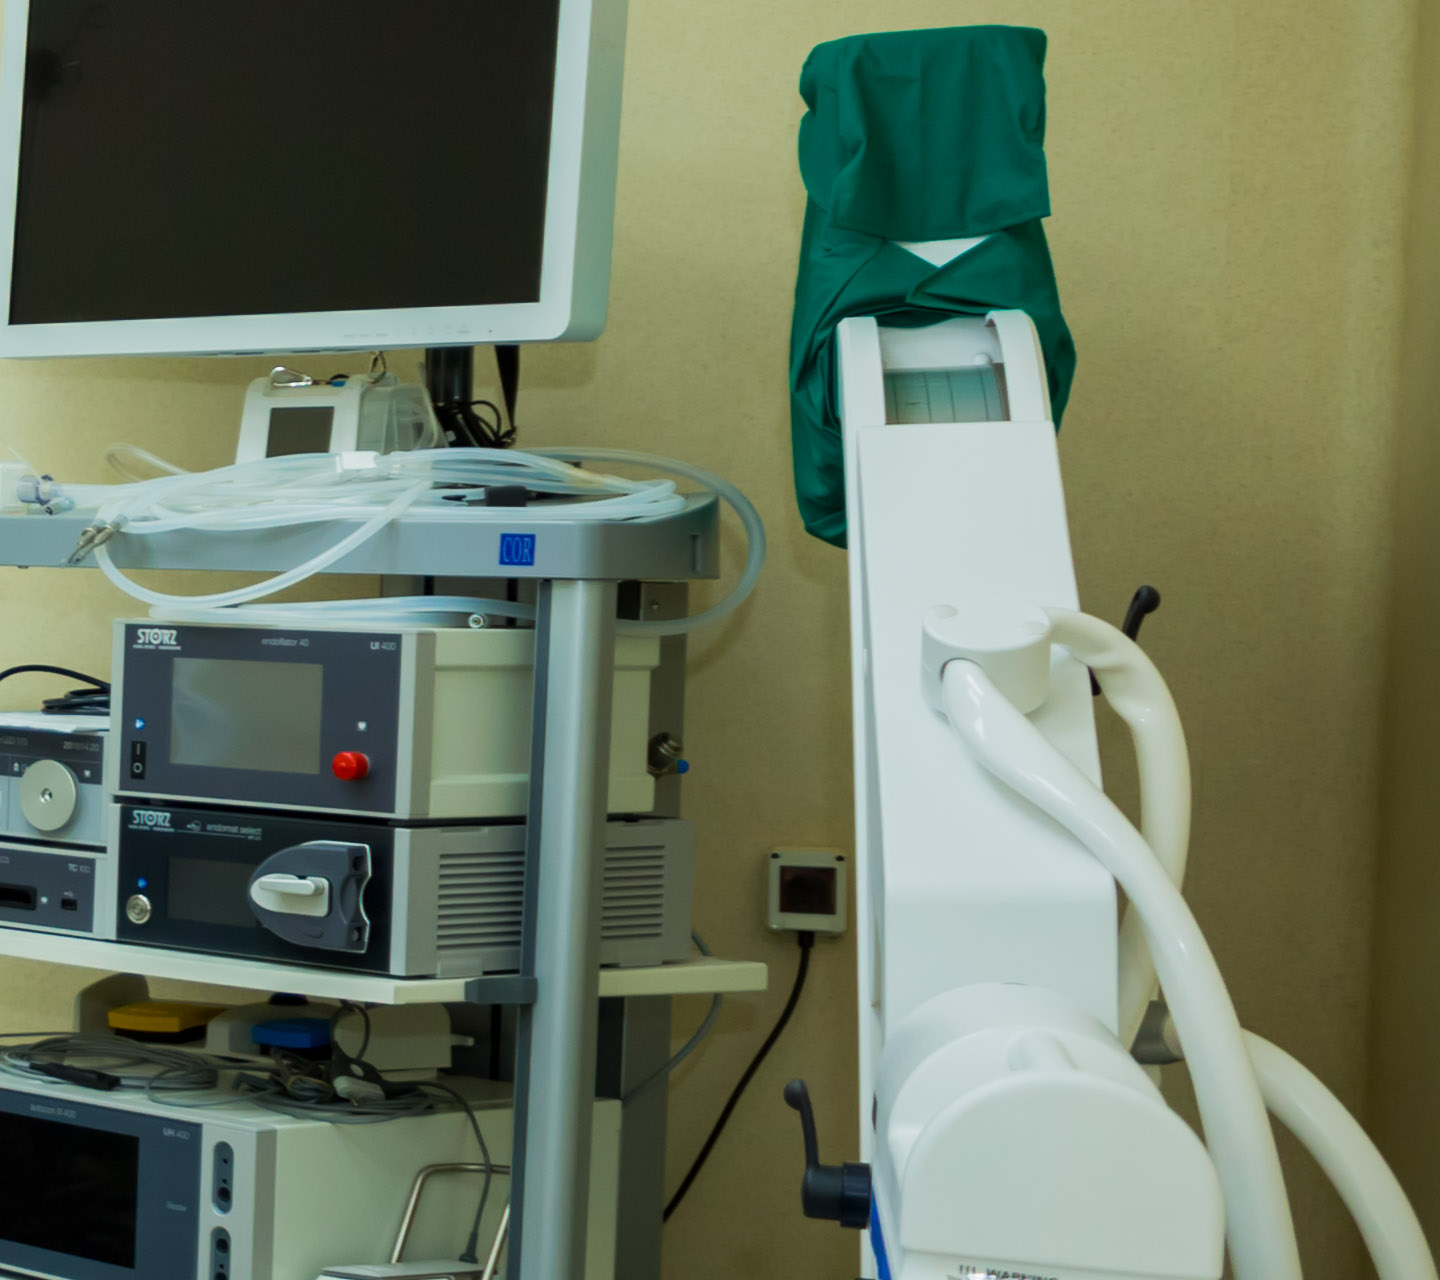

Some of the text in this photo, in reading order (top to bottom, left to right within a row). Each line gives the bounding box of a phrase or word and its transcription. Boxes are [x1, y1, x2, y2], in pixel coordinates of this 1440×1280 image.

[503, 536, 532, 563] COR
[136, 628, 178, 646] STORZ
[133, 809, 172, 827] STORZ
